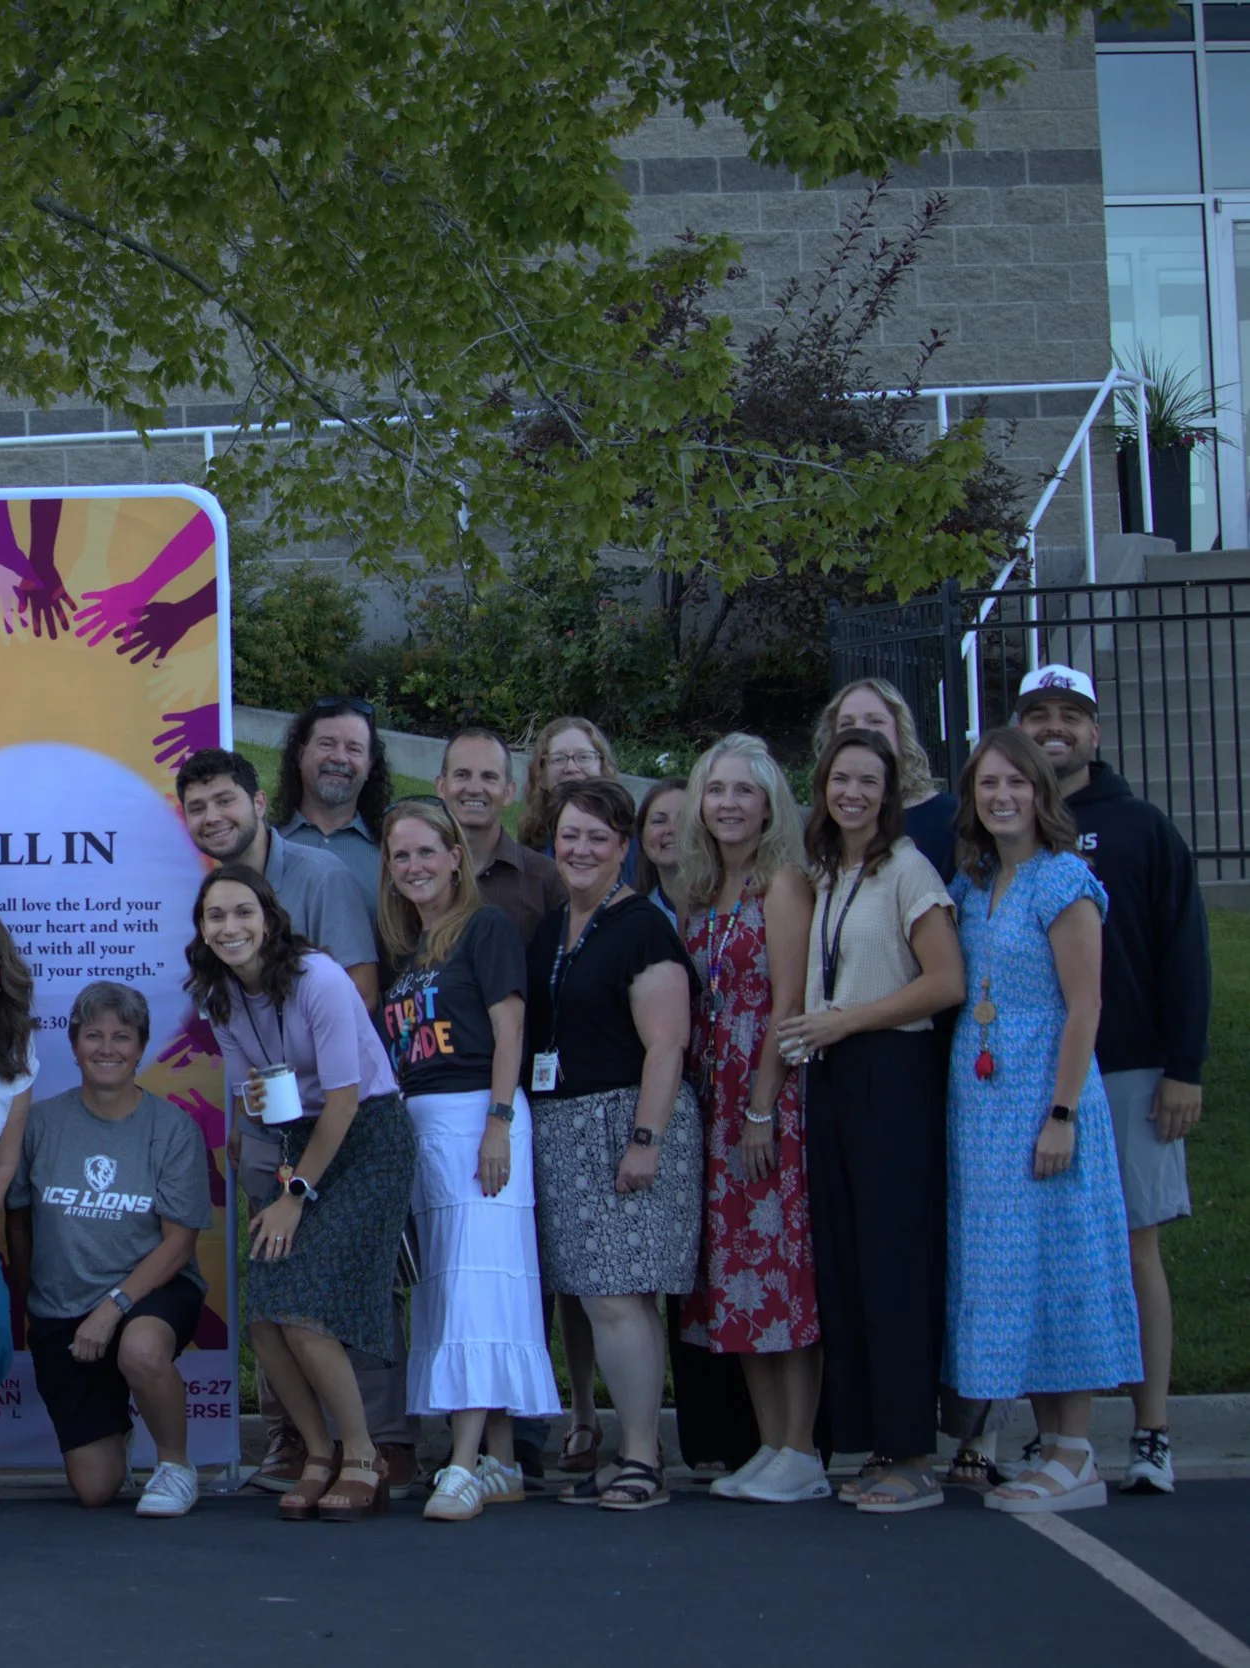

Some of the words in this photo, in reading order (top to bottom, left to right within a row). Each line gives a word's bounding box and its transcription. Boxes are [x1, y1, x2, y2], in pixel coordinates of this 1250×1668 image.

[61, 831, 117, 865] IN
[22, 898, 52, 912] love
[56, 897, 80, 912] the
[85, 897, 122, 912] Lord
[126, 901, 162, 917] your
[7, 923, 42, 937] your
[46, 919, 86, 933] heart
[90, 919, 119, 933] and
[123, 918, 159, 933] with
[15, 941, 32, 955] nd
[37, 941, 72, 955] with
[77, 941, 96, 955] all
[100, 945, 136, 960] your
[47, 967, 83, 982] your
[384, 985, 439, 1040] FIRST
[390, 1020, 455, 1073] ADE
[41, 1186, 80, 1205] ICS
[79, 1190, 153, 1214] LIONS
[63, 1205, 123, 1221] ATHLETICS
[185, 1403, 232, 1418] ERSE
